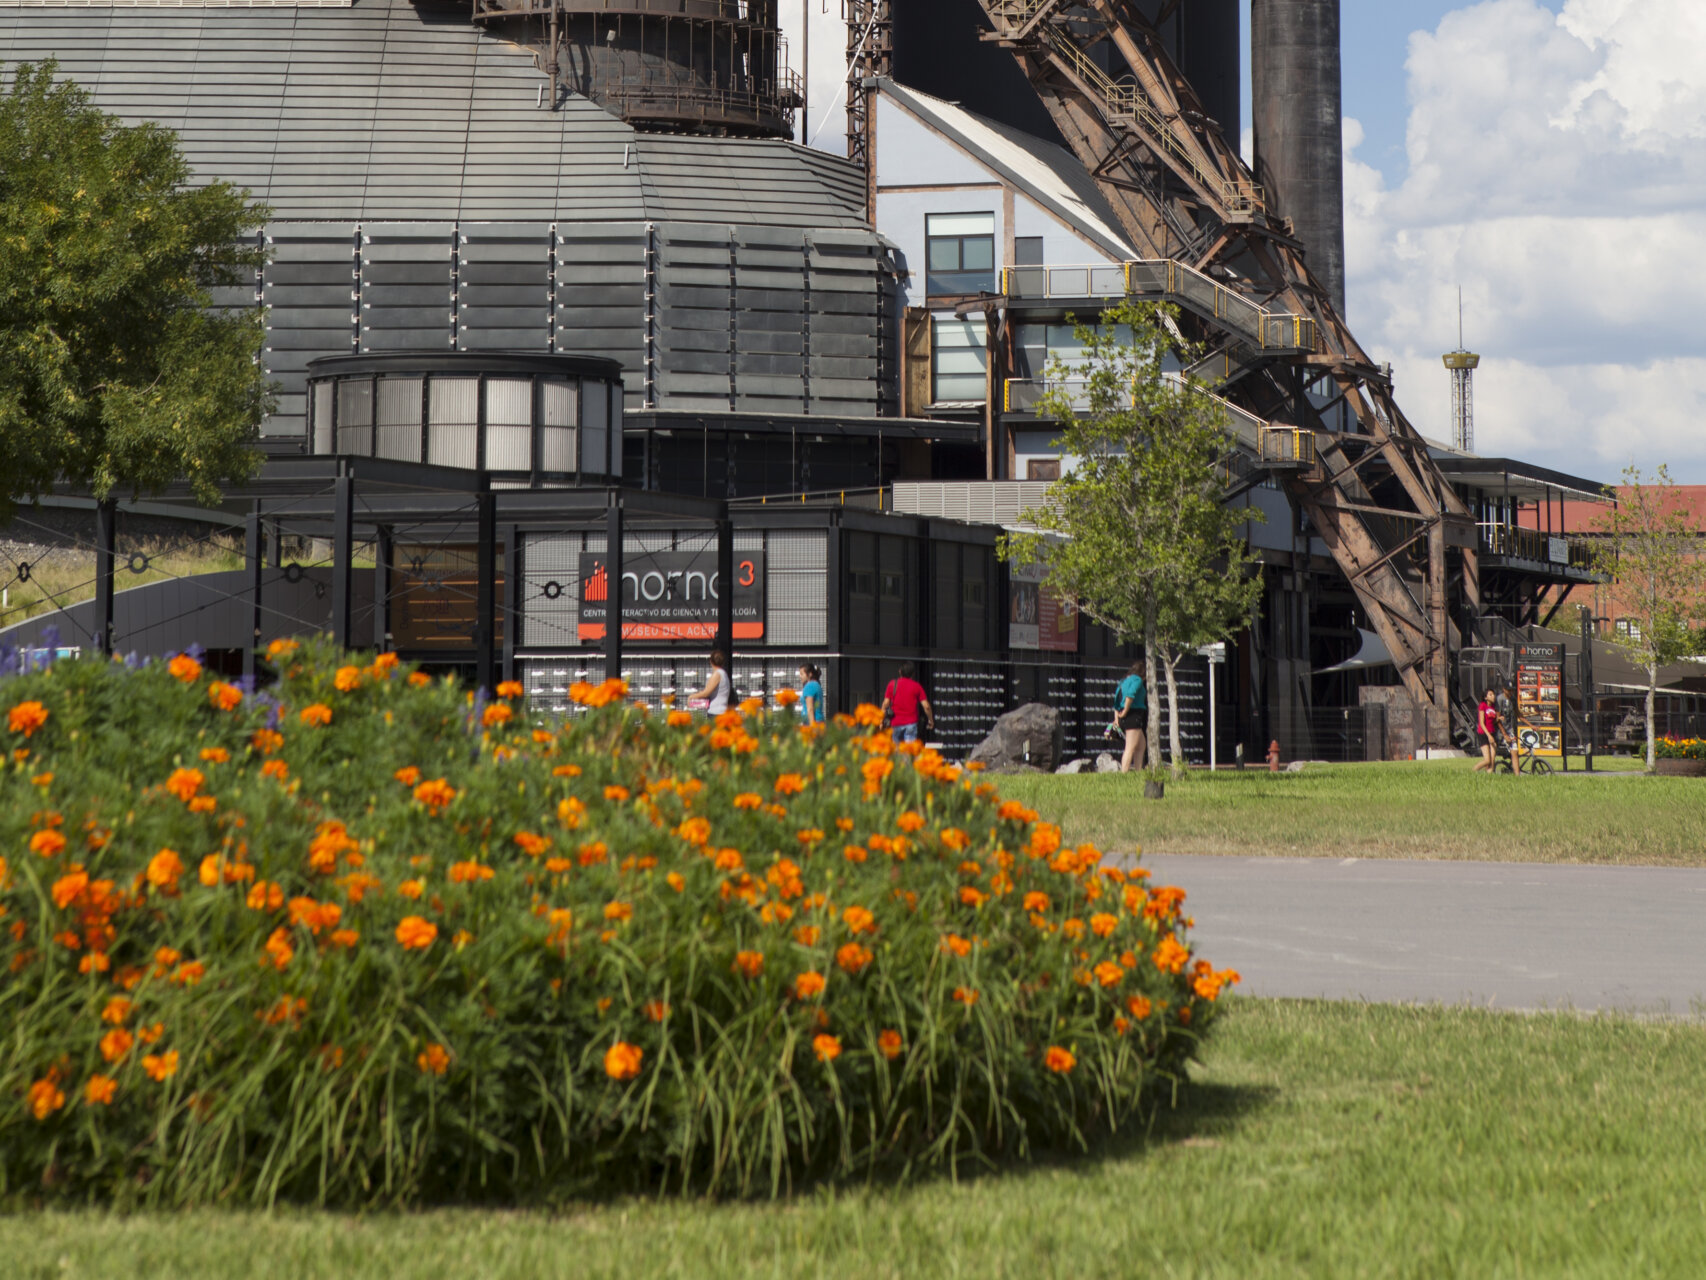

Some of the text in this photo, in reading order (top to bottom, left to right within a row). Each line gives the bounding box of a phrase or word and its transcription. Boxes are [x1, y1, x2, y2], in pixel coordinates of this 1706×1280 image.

[739, 560, 755, 587] 3
[583, 609, 607, 617] CENTR
[621, 608, 659, 617] TERACTIVO
[661, 608, 671, 617] DE
[672, 608, 701, 617] CIENCIA
[703, 608, 709, 616] Y
[621, 625, 659, 636] MUSEO
[662, 625, 684, 636] DEL
[1527, 645, 1553, 655] horno
